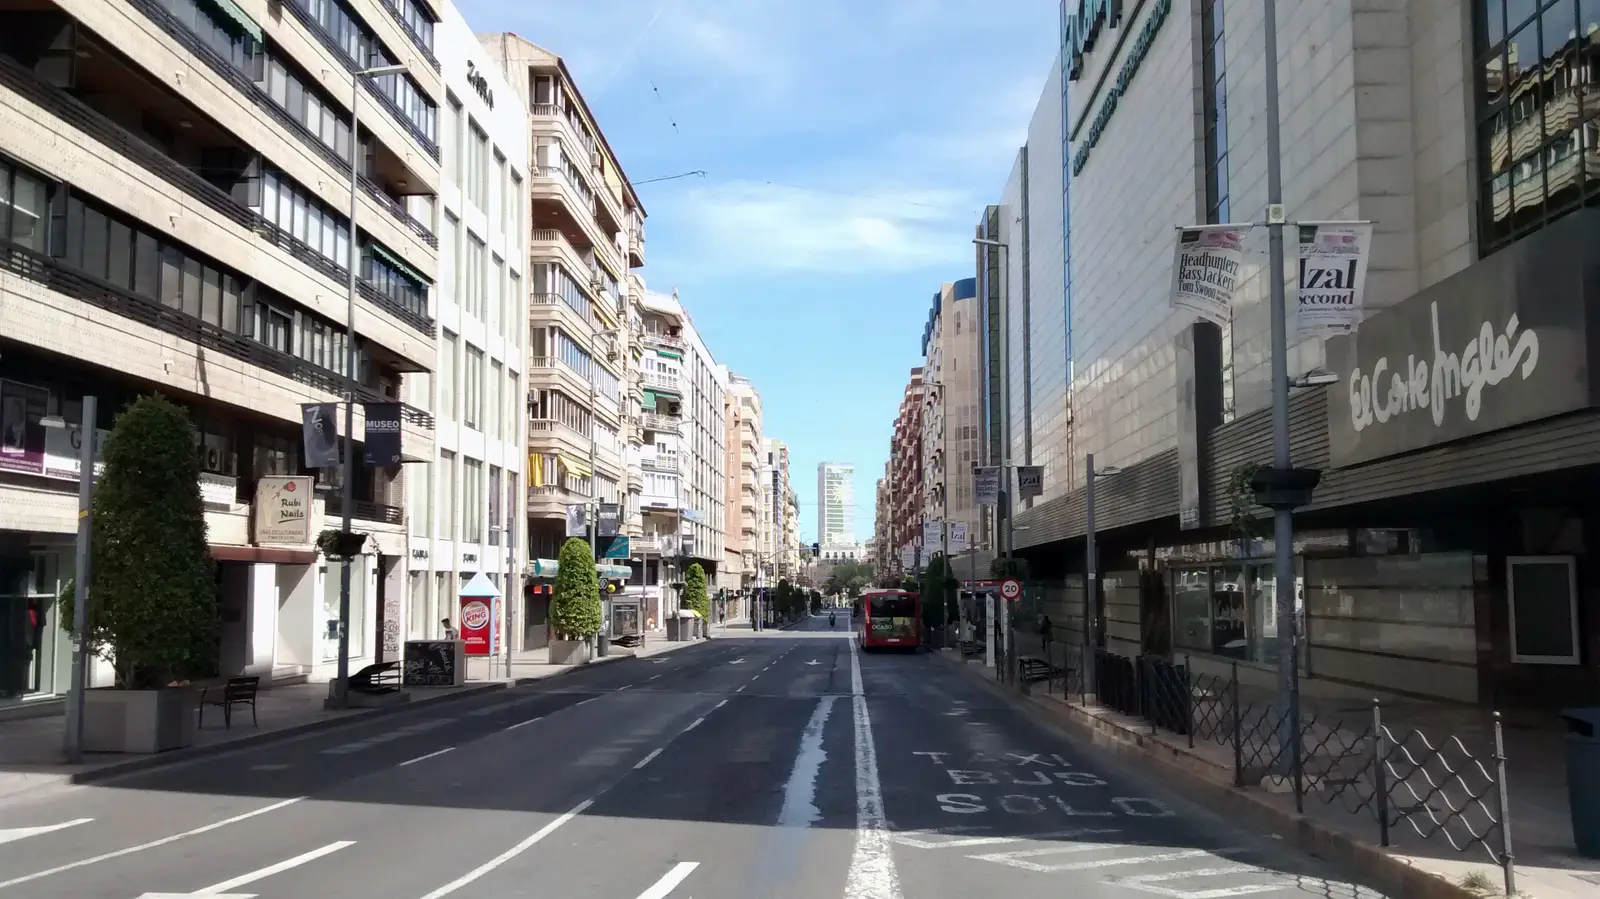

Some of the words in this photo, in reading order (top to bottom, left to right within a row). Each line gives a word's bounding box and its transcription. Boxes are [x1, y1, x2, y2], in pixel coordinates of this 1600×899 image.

[467, 60, 495, 112] ZARA
[1181, 251, 1239, 276] Headhunterz
[1300, 258, 1357, 289] Izal
[1178, 280, 1194, 292] Tom
[1195, 281, 1216, 299] Swoon
[1350, 367, 1373, 432] El
[1372, 353, 1430, 424] Corte
[1431, 300, 1539, 427] Inglés
[366, 420, 400, 429] MUSEO
[281, 498, 302, 508] Rubi
[280, 510, 304, 520] Nails
[1005, 585, 1017, 593] 20
[466, 611, 486, 622] KING
[946, 769, 1109, 786] BUS
[936, 793, 1176, 817] SOLO
